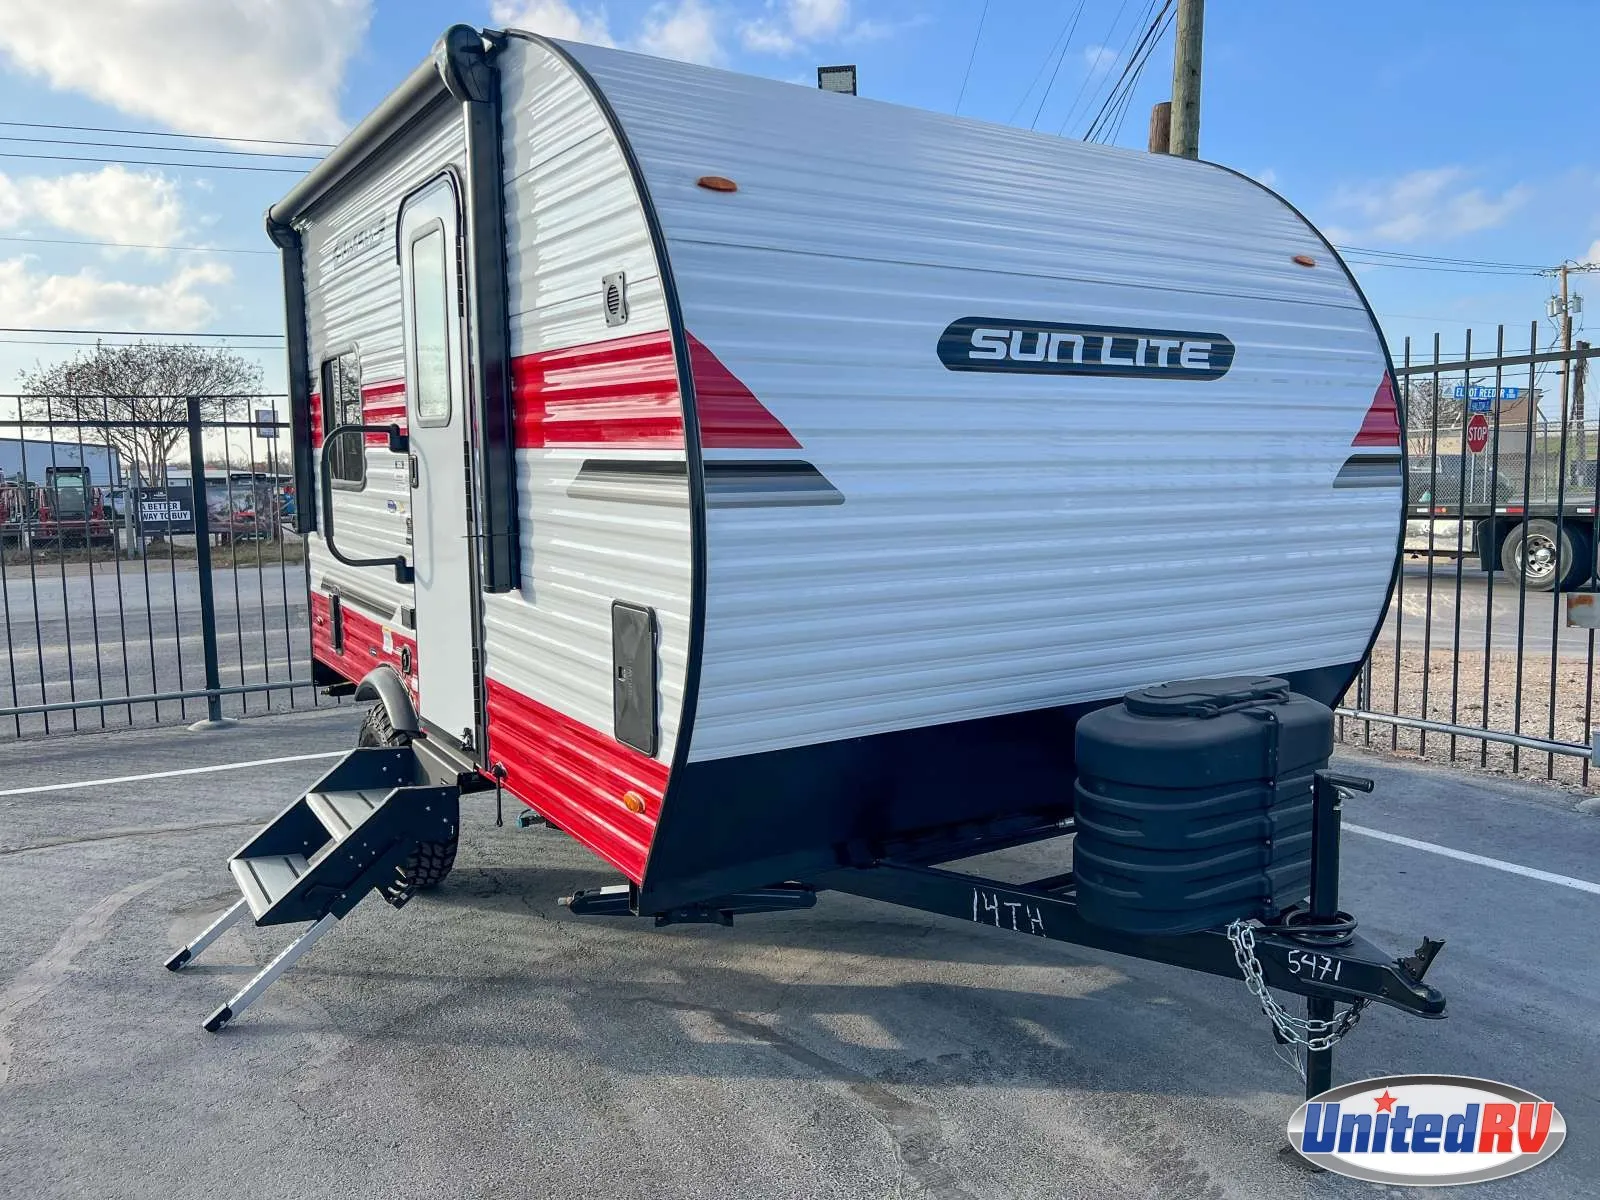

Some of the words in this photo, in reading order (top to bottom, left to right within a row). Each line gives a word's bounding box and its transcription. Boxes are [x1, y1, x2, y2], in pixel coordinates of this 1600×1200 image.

[968, 327, 1084, 364] SUN
[1100, 336, 1212, 370] LITE
[1479, 388, 1505, 399] REEDR
[1468, 426, 1487, 441] STOP
[171, 511, 188, 520] BUY
[973, 887, 1047, 938] 14TH
[1287, 949, 1342, 981] 5471
